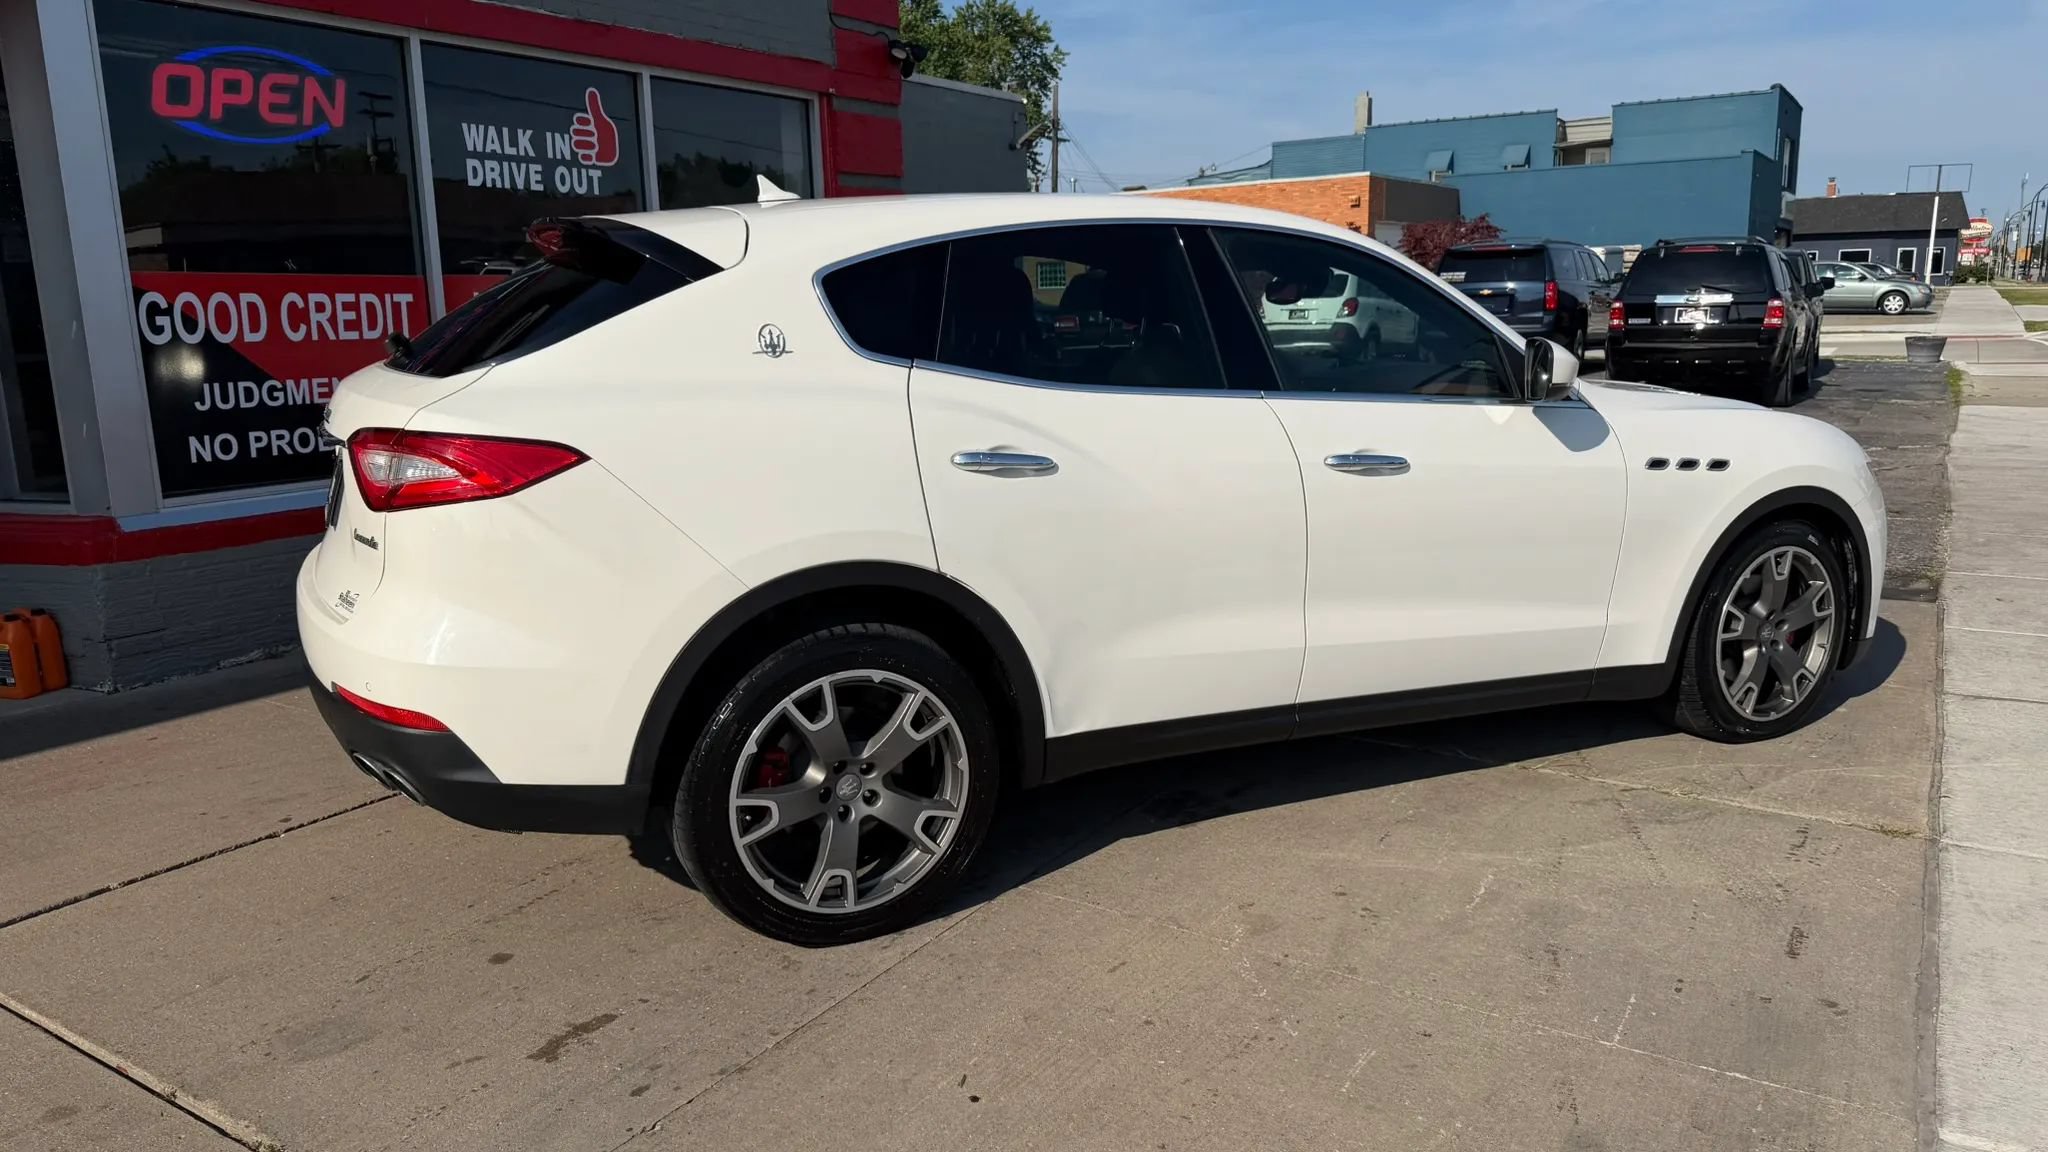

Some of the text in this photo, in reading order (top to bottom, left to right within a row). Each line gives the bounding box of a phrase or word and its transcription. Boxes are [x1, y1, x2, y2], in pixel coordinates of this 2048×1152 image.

[151, 63, 346, 127] OPEN
[461, 122, 571, 160] WALK IN
[465, 158, 602, 195] DRIVE OUT
[138, 291, 414, 345] GOOD CREDIT
[188, 433, 239, 464] NO
